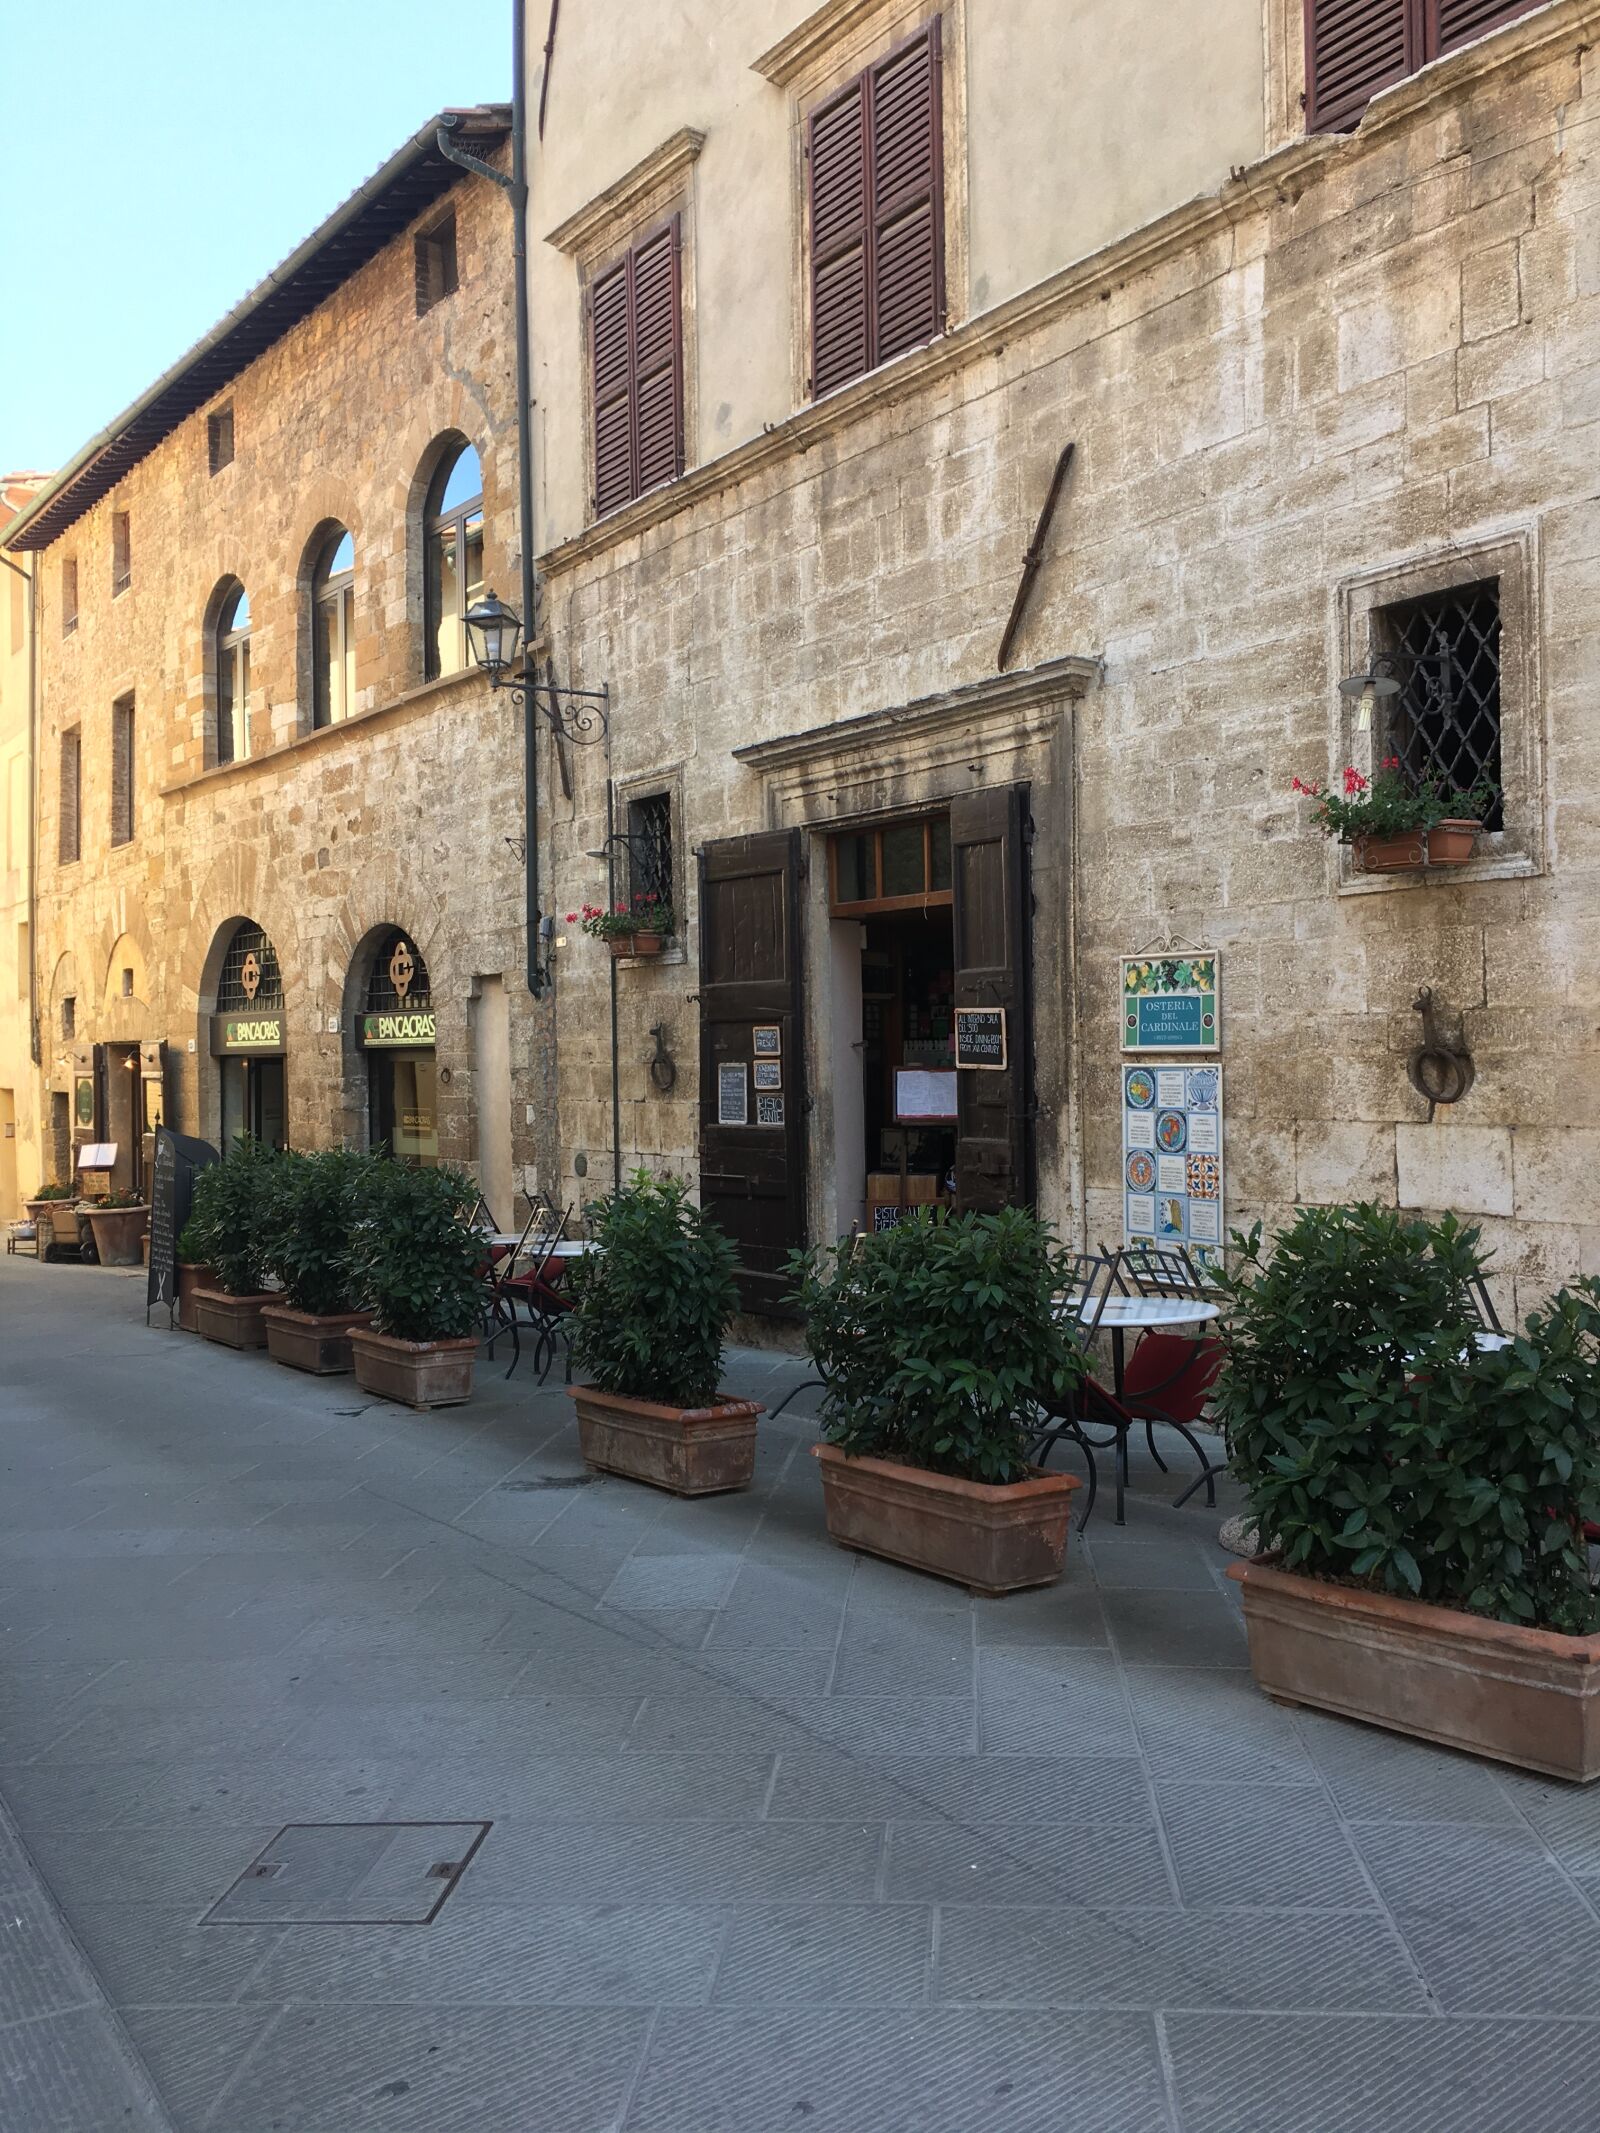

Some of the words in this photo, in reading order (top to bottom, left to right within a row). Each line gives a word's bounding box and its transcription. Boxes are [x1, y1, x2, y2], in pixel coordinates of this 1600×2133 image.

[1146, 1001, 1193, 1011] OSTERIA
[1161, 1012, 1178, 1021] DEL
[1141, 1021, 1199, 1032] CARDINALE
